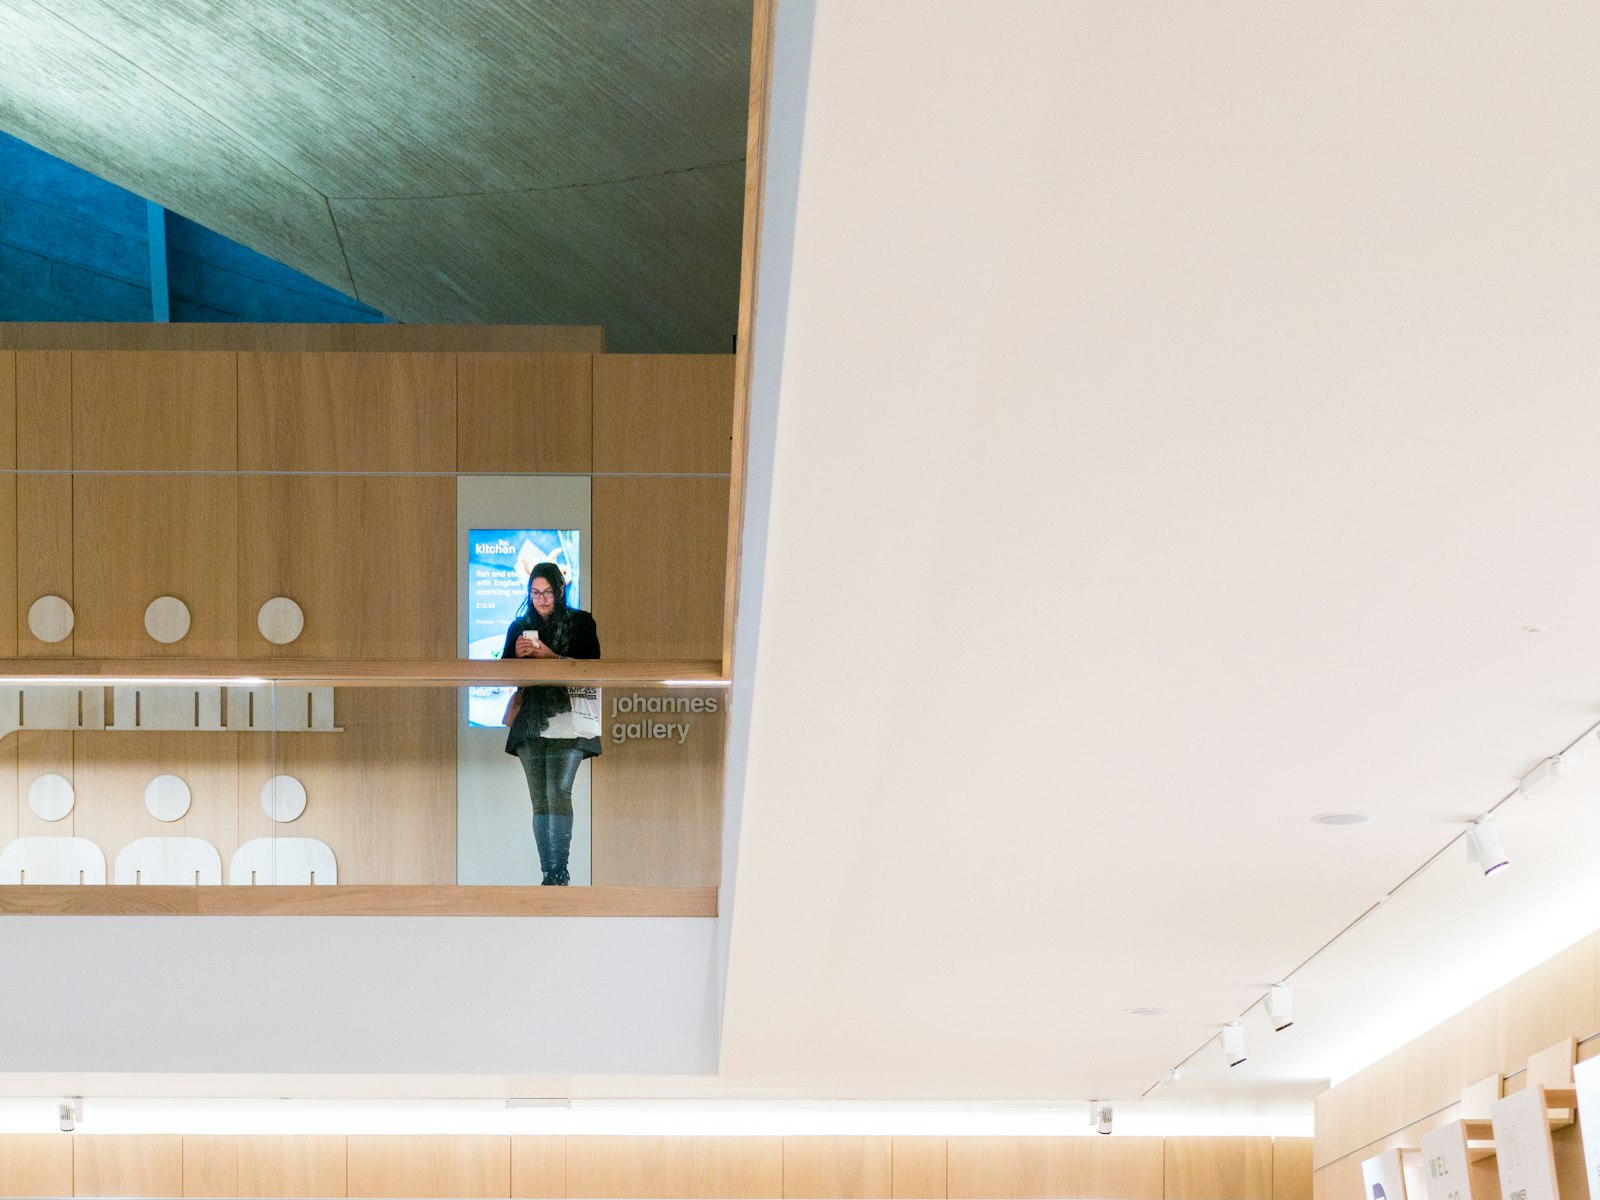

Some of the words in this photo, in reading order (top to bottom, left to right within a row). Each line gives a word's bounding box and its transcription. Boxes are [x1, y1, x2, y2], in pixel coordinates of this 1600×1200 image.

[475, 543, 516, 554] kitchen
[494, 579, 521, 588] English
[476, 588, 511, 597] sparkling
[611, 693, 718, 718] johannes
[612, 720, 690, 744] gallery
[1429, 1154, 1449, 1180] WEL
